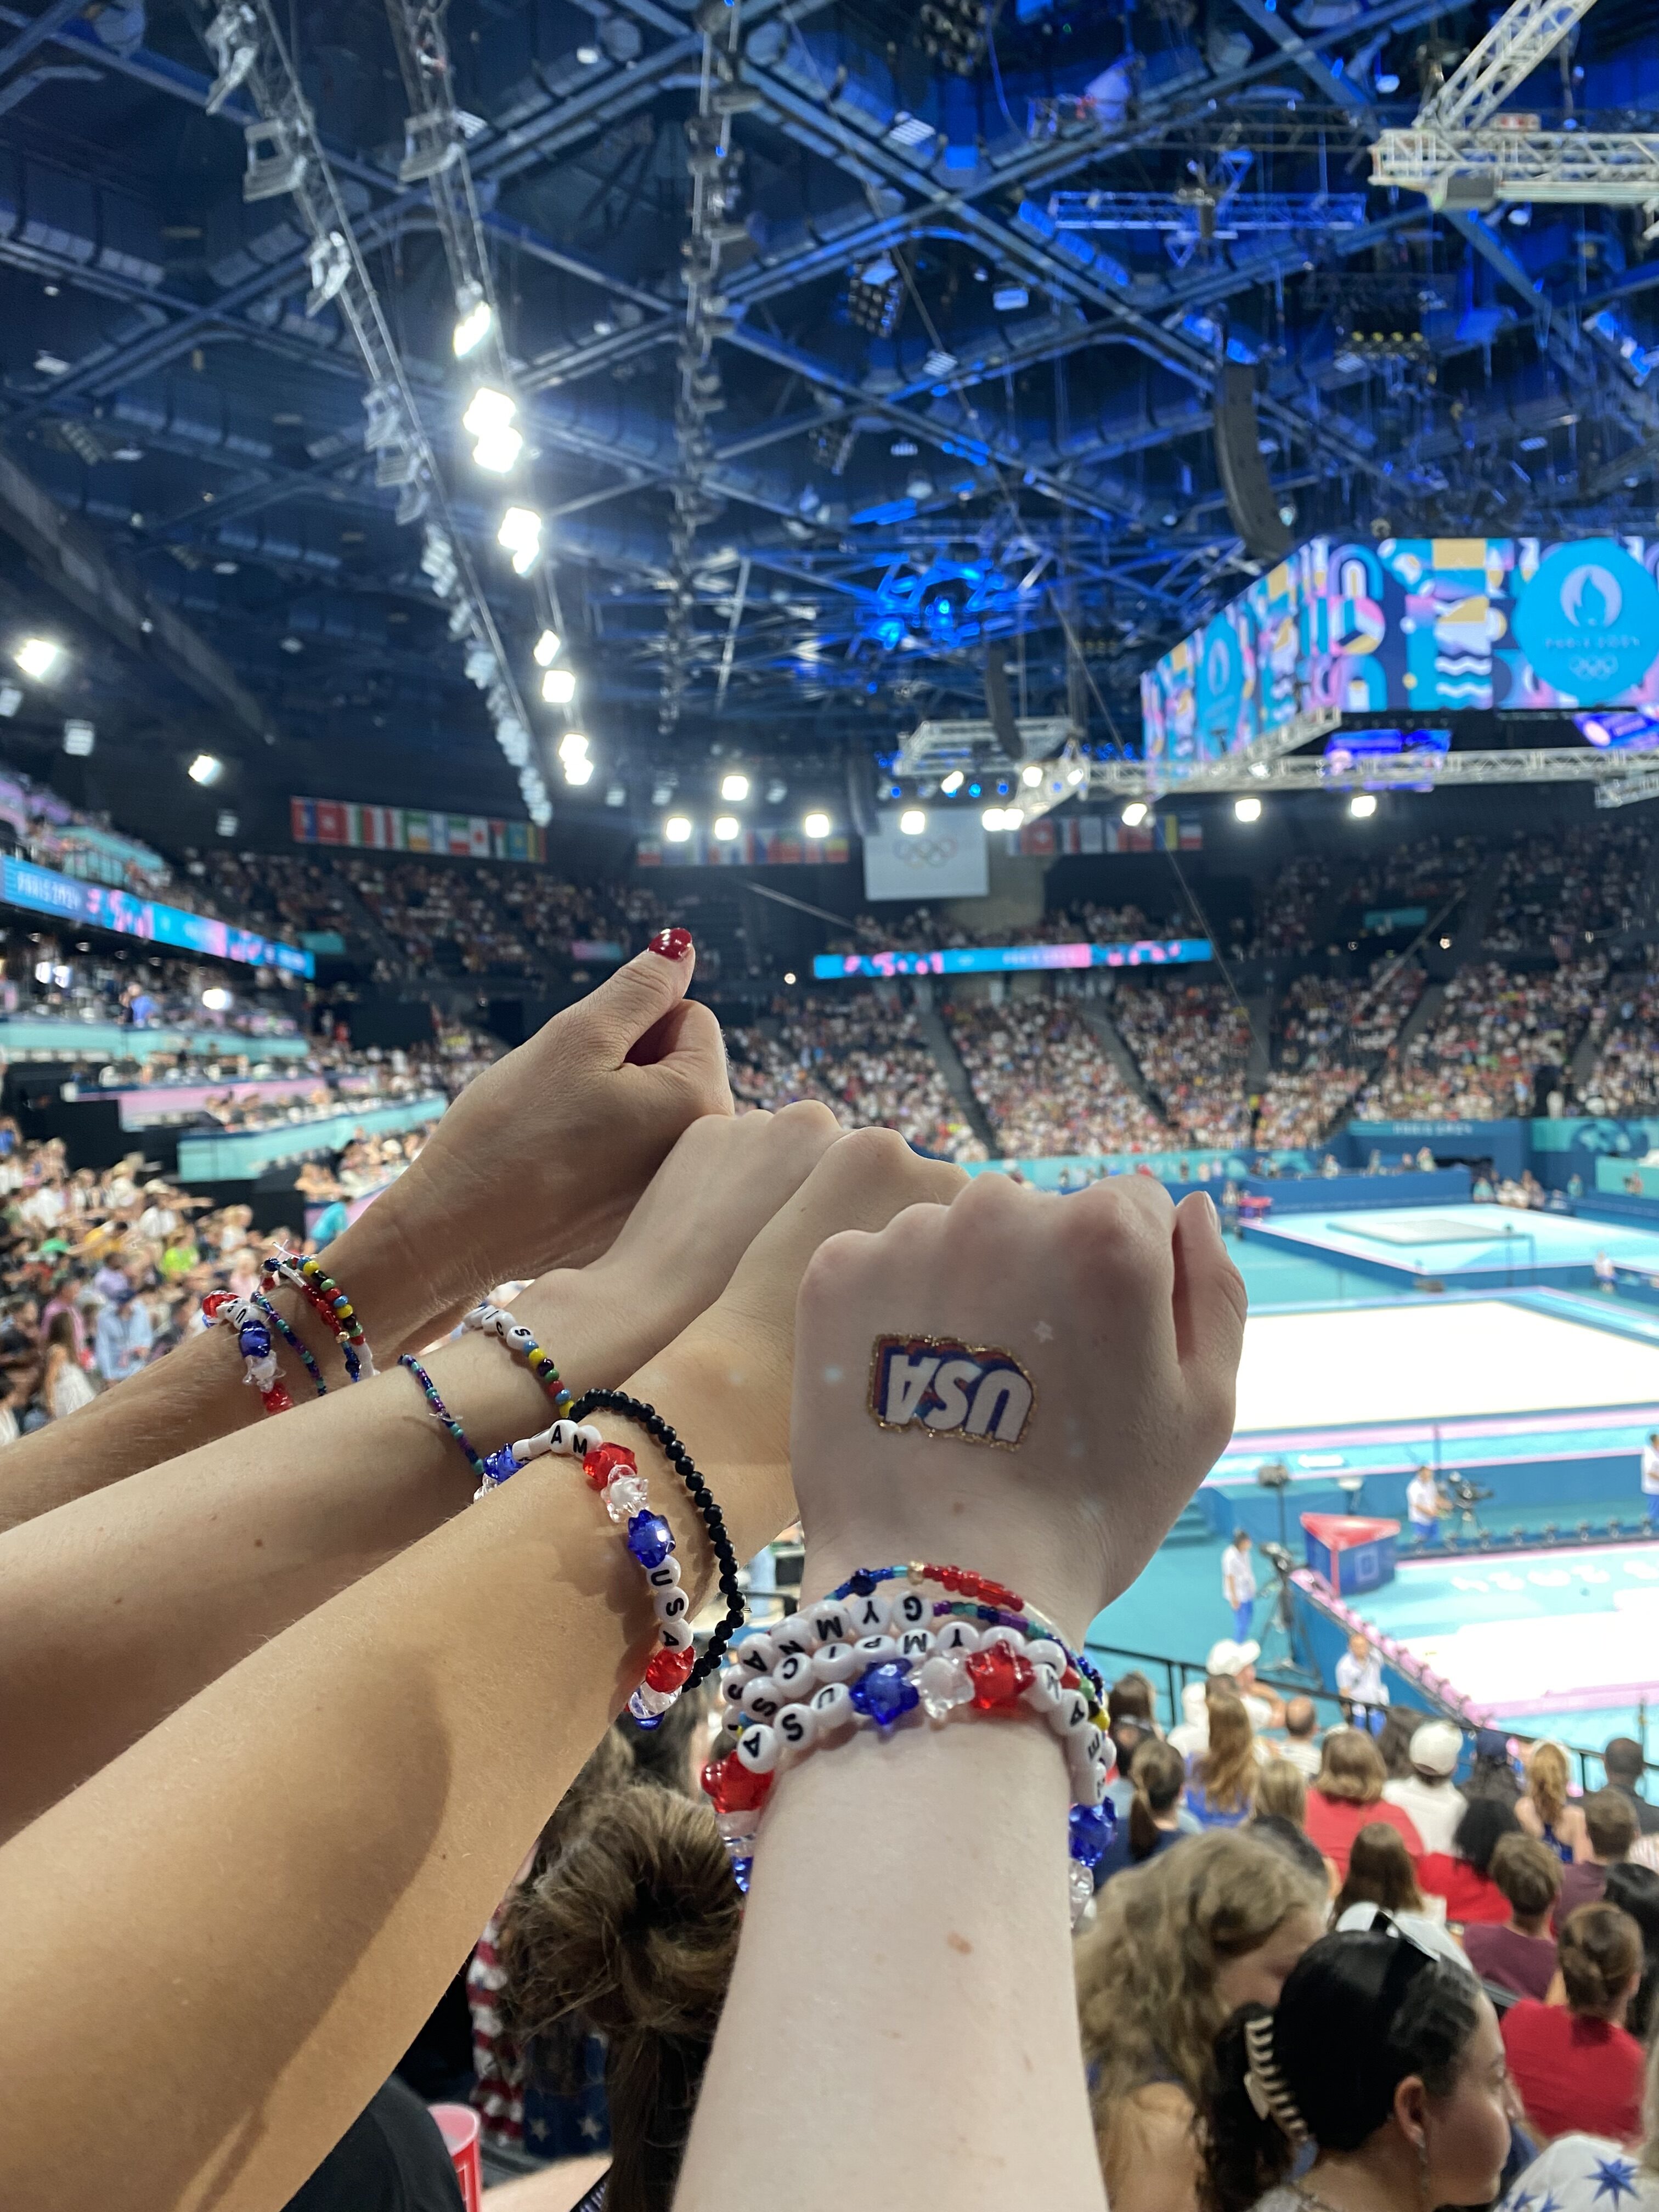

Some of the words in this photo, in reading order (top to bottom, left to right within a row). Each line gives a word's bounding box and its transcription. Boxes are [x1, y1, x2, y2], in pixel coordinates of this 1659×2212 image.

[885, 1354, 1032, 1442] USA
[651, 1570, 685, 1646] USA
[727, 1595, 923, 1728] GYMNAS
[743, 1688, 834, 1758] USA
